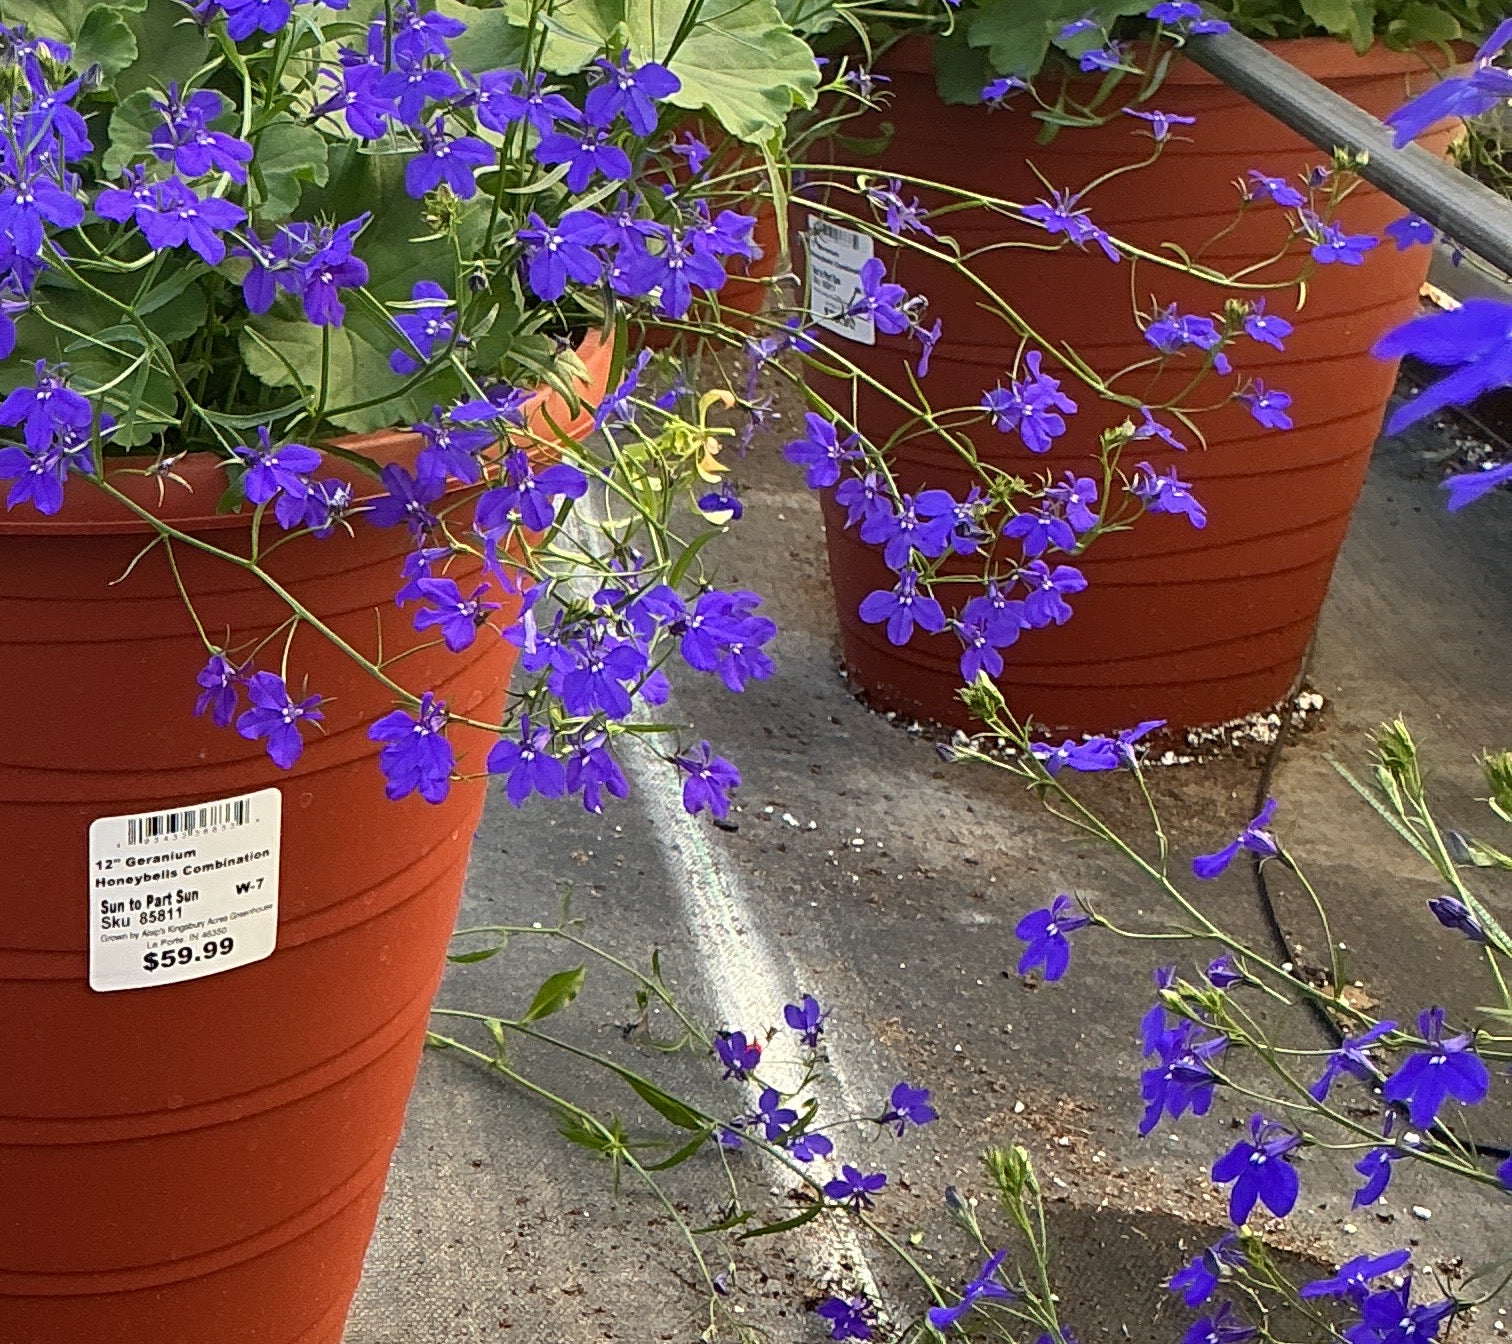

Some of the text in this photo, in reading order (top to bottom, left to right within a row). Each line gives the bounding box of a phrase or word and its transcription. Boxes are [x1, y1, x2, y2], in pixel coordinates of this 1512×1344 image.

[96, 849, 270, 888] Honeybells Combination
[125, 849, 196, 867] Geranium
[235, 878, 264, 895] W-7
[101, 889, 199, 914] Sun to Part Sun
[101, 906, 182, 929] Sku 85811
[129, 932, 140, 940] by
[143, 937, 234, 972] $59.99
